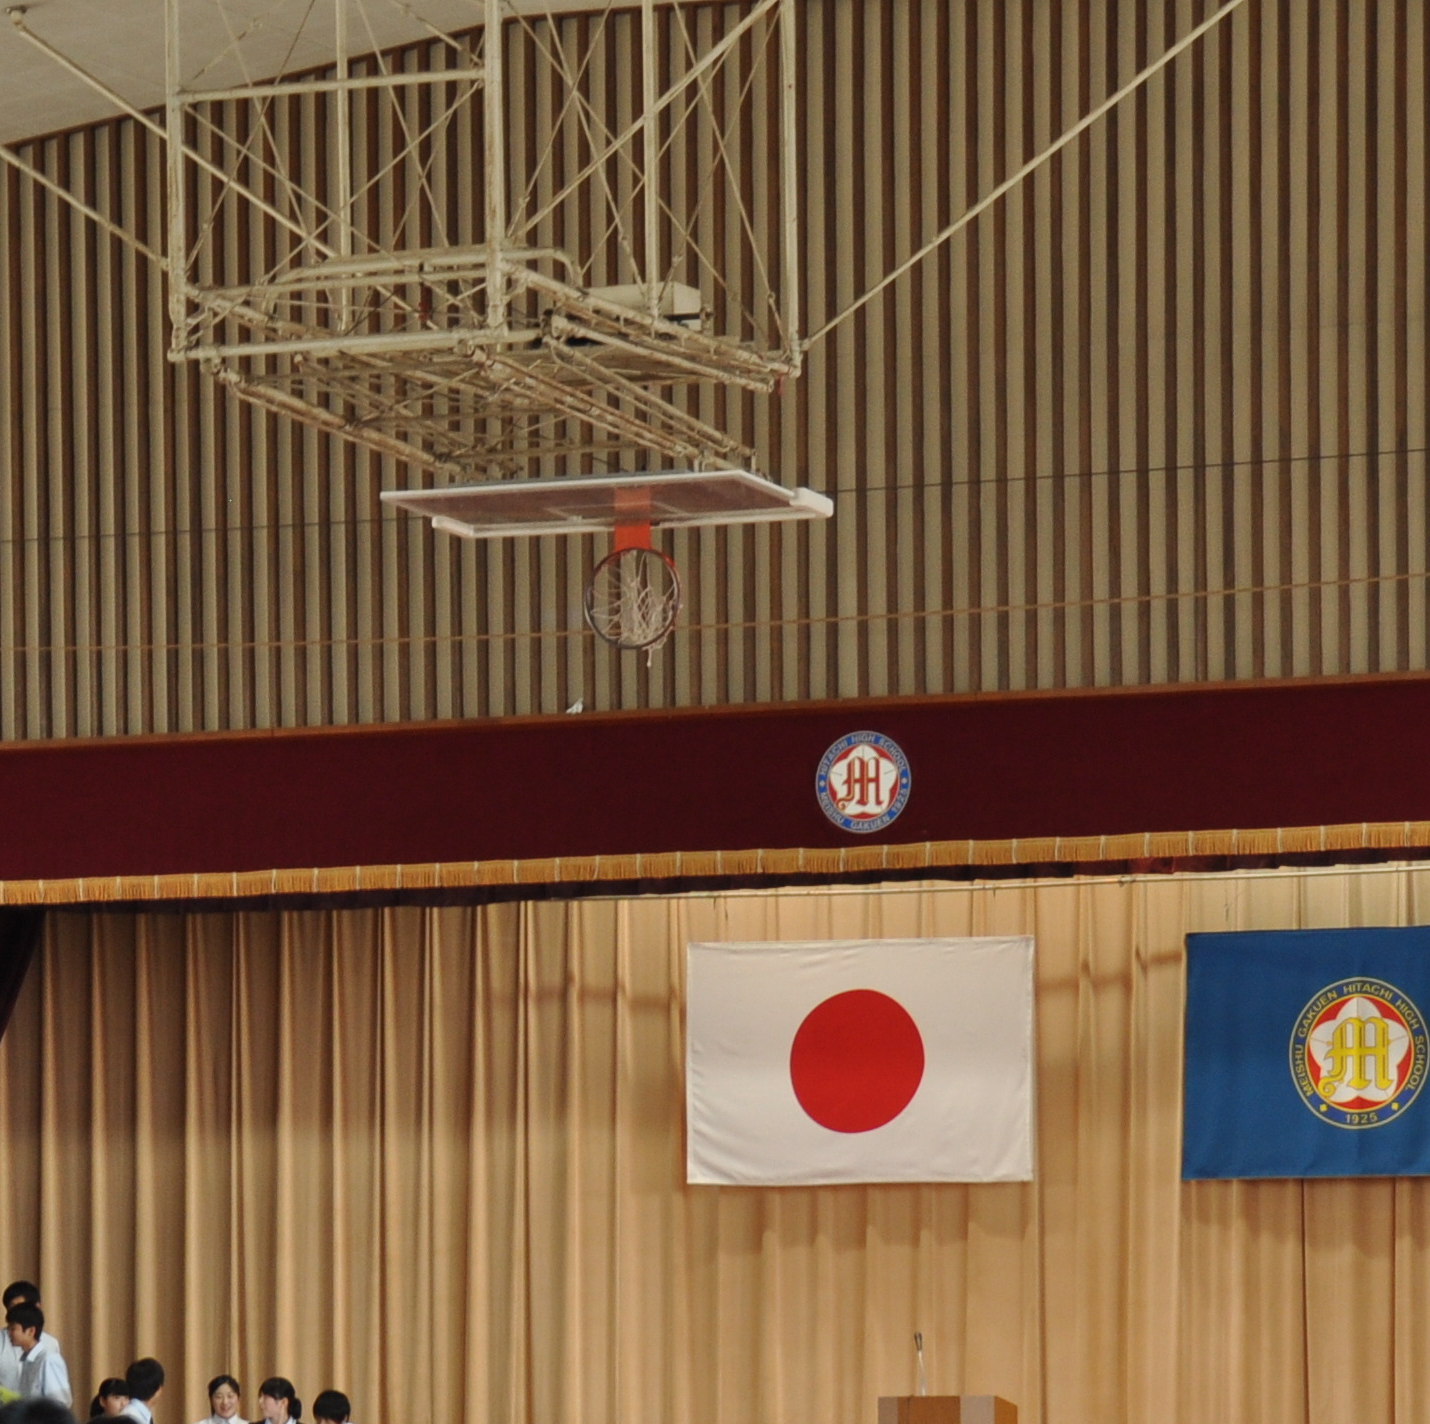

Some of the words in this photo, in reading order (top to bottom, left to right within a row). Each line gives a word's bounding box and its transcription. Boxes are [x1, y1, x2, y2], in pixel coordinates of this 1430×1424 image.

[1297, 990, 1338, 1038] GAKUEN
[1342, 982, 1394, 1000] HITACHI
[1395, 999, 1420, 1029] HIGH
[1294, 1044, 1314, 1097] MEISHU
[1405, 1035, 1426, 1091] SCHOOL
